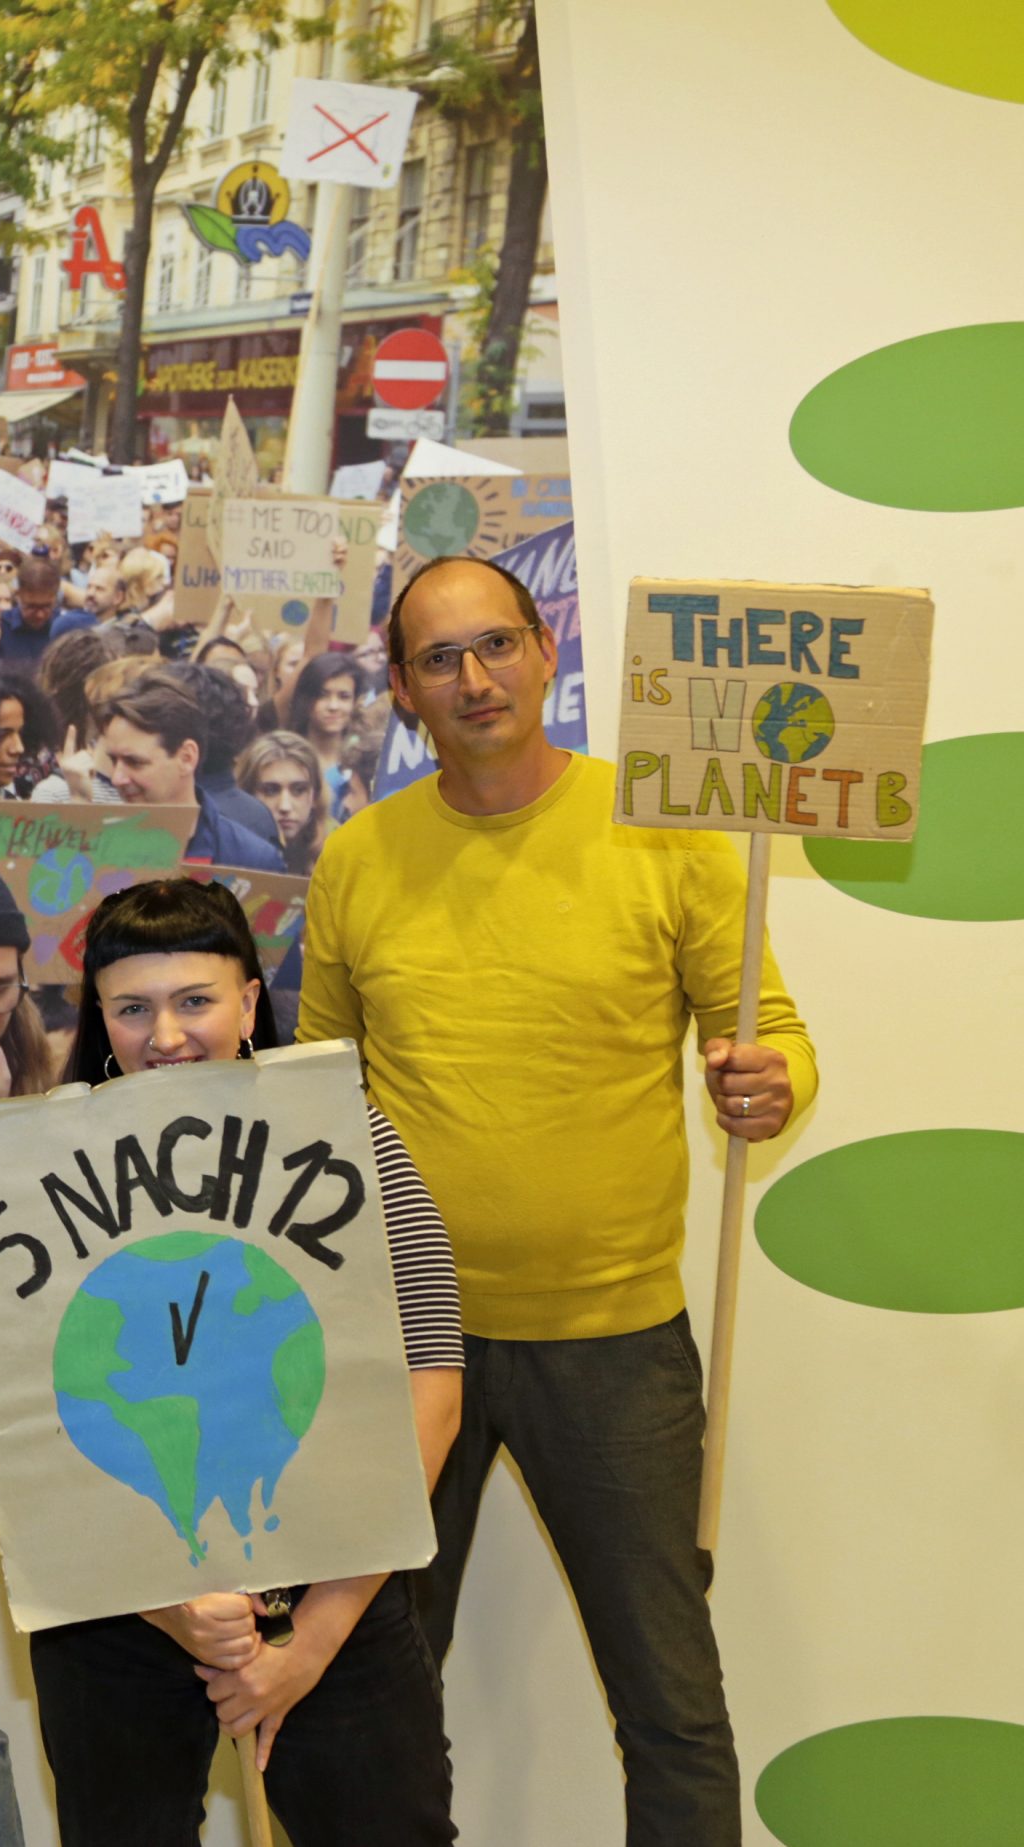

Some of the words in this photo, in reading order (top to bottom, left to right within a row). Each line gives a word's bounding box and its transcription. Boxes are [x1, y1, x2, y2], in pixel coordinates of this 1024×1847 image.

[224, 566, 290, 592] MOTHER
[247, 536, 296, 560] SAID
[648, 593, 866, 680] THERE
[631, 655, 672, 706] is
[623, 750, 864, 829] PLANET
[876, 771, 913, 828] B
[40, 1114, 270, 1260] NACH
[267, 1139, 366, 1271] 12
